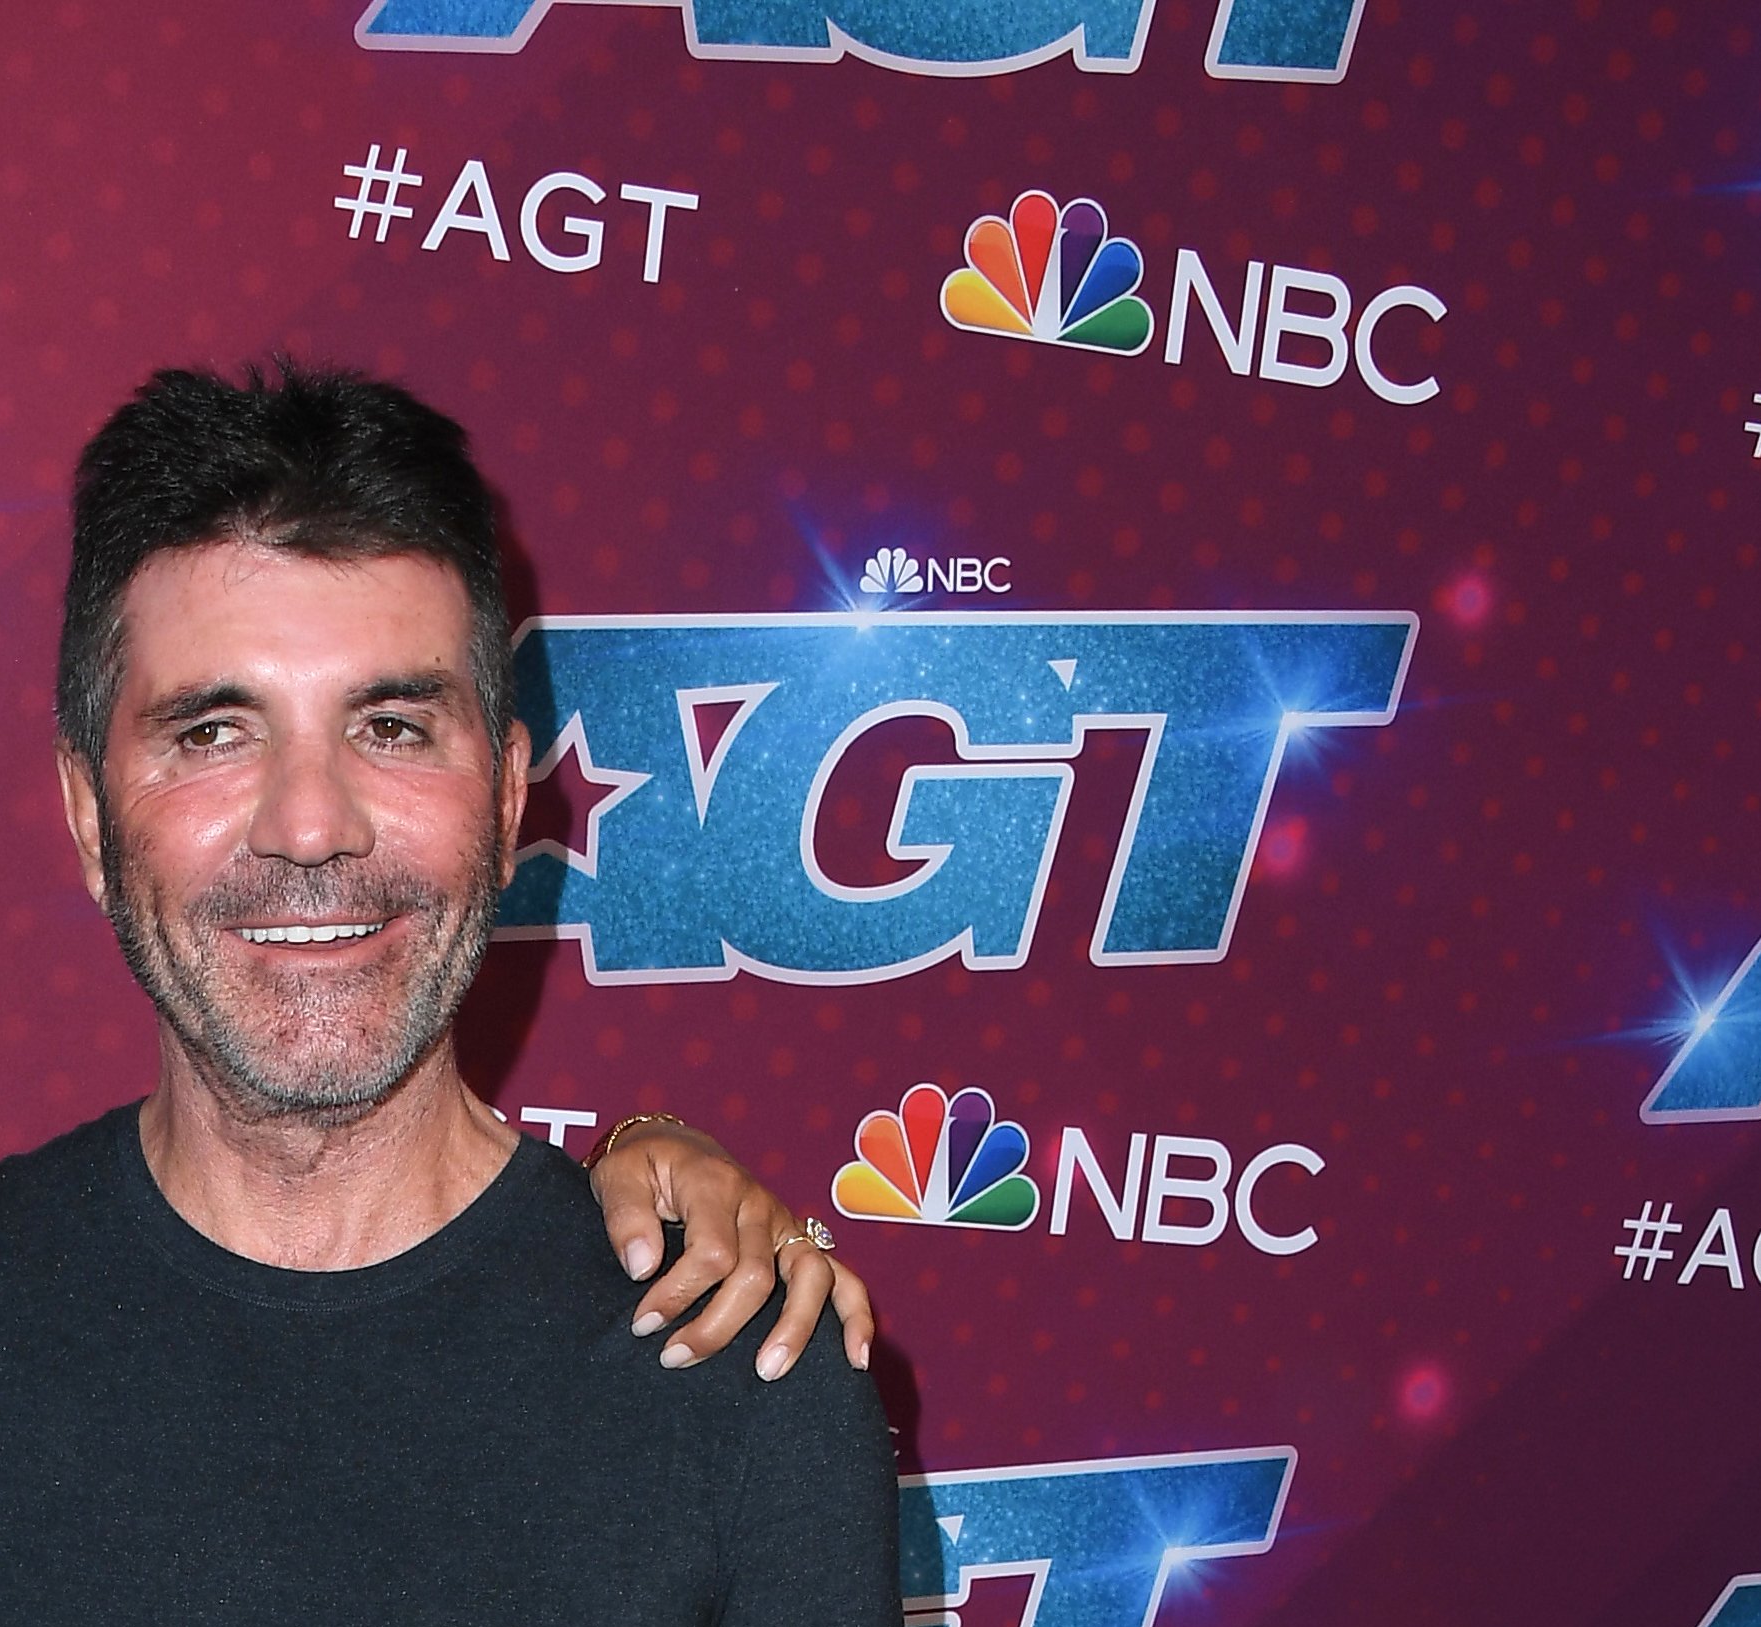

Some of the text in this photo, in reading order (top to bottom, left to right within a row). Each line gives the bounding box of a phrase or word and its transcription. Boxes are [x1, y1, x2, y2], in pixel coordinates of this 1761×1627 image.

[335, 144, 698, 282] #AGT
[1165, 249, 1447, 404] NBC
[927, 557, 1011, 593] NBC
[1050, 1127, 1325, 1254] NBC
[1615, 1201, 1761, 1289] #A
